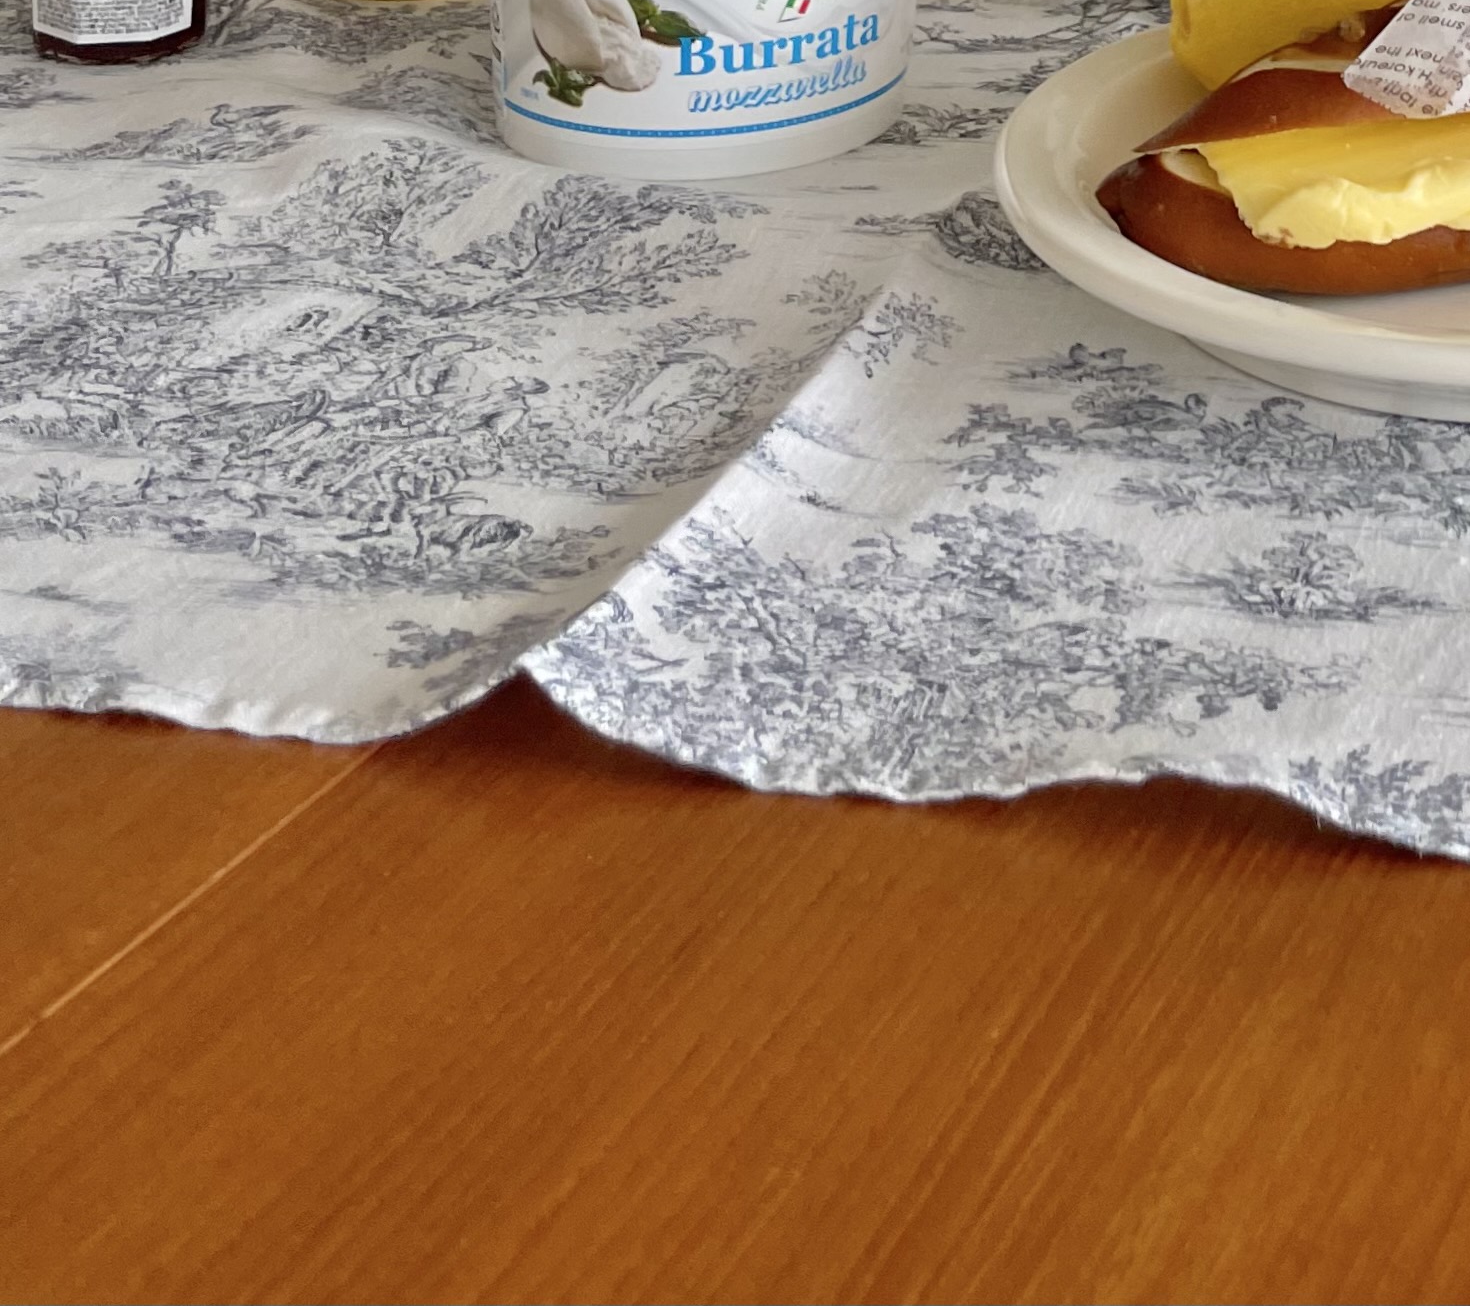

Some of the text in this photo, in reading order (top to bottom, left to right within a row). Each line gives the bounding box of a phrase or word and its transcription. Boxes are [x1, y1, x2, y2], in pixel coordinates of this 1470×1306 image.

[1418, 14, 1465, 30] smell
[674, 10, 880, 77] Burrata
[1375, 44, 1444, 64] next the
[687, 54, 868, 114] mozzarella
